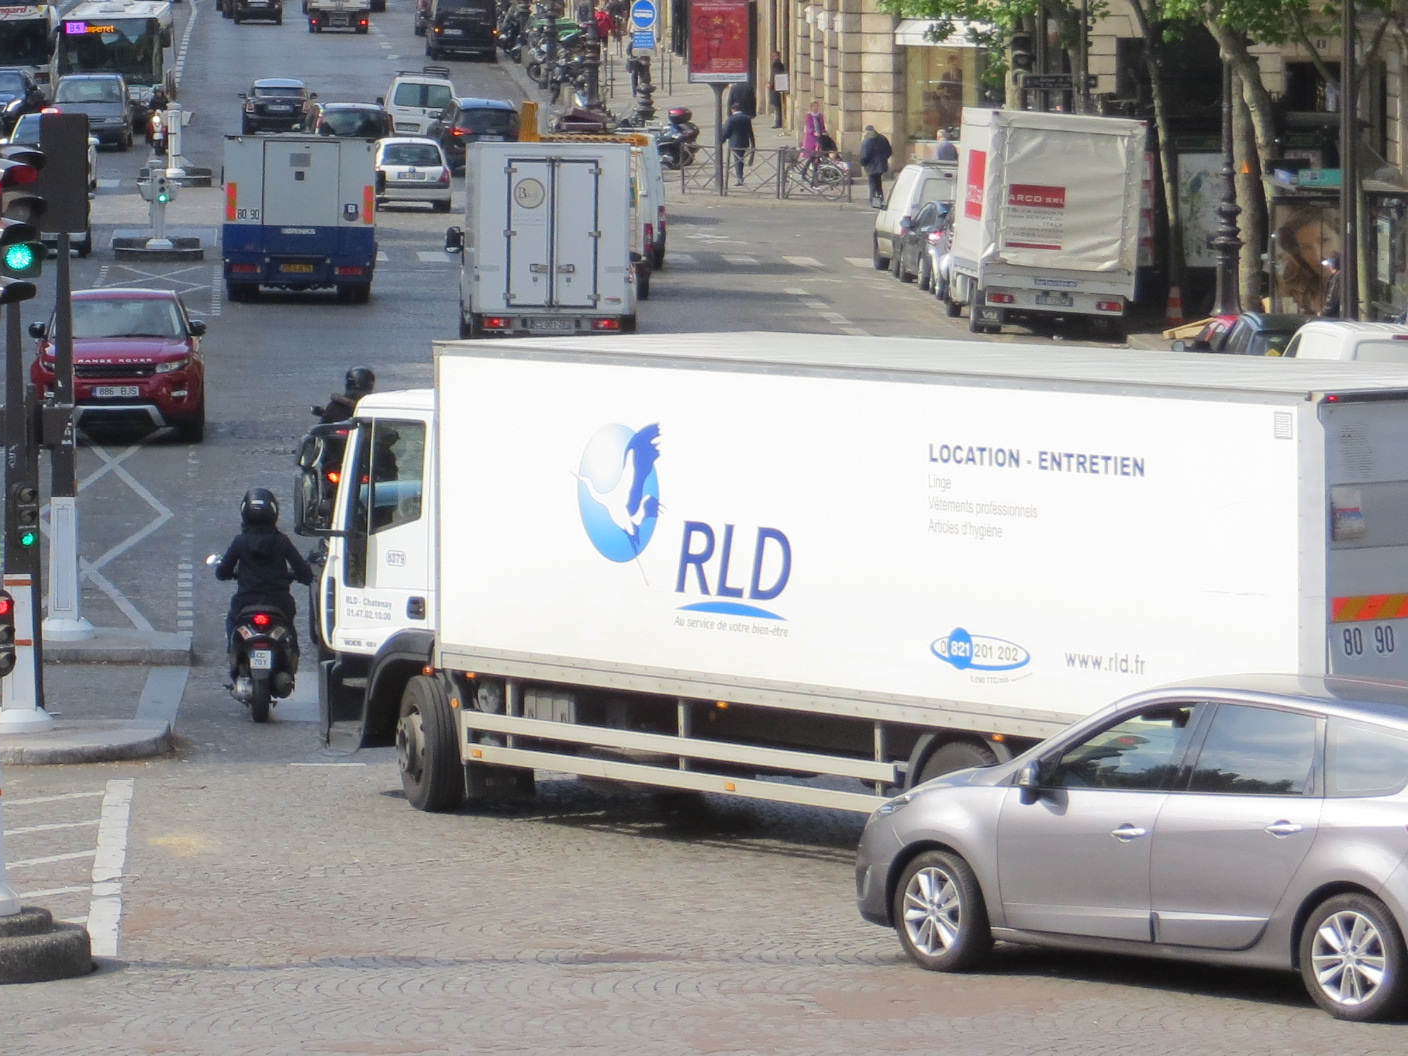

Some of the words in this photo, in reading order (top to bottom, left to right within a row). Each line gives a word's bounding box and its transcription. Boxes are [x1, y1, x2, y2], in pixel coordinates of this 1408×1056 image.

[237, 208, 247, 219] 80
[250, 208, 260, 220] 90
[928, 442, 1021, 469] LOCATION
[1038, 450, 1145, 478] ENTRETIEN
[928, 473, 952, 492] Linge
[928, 495, 974, 514] Vêtements
[976, 500, 1038, 520] professionnels
[928, 517, 960, 536] Articles
[961, 521, 1003, 541] d'hygiène
[674, 520, 792, 601] RLD
[345, 595, 358, 605] RLD
[674, 615, 685, 626] Au
[687, 618, 715, 630] service
[717, 620, 727, 631] de
[729, 621, 750, 633] votre
[950, 640, 971, 658] 821
[974, 643, 994, 660] 201
[998, 645, 1019, 662] 202
[1343, 627, 1363, 656] 80
[1374, 624, 1395, 654] 90
[1064, 651, 1146, 675] www.rld.fr
